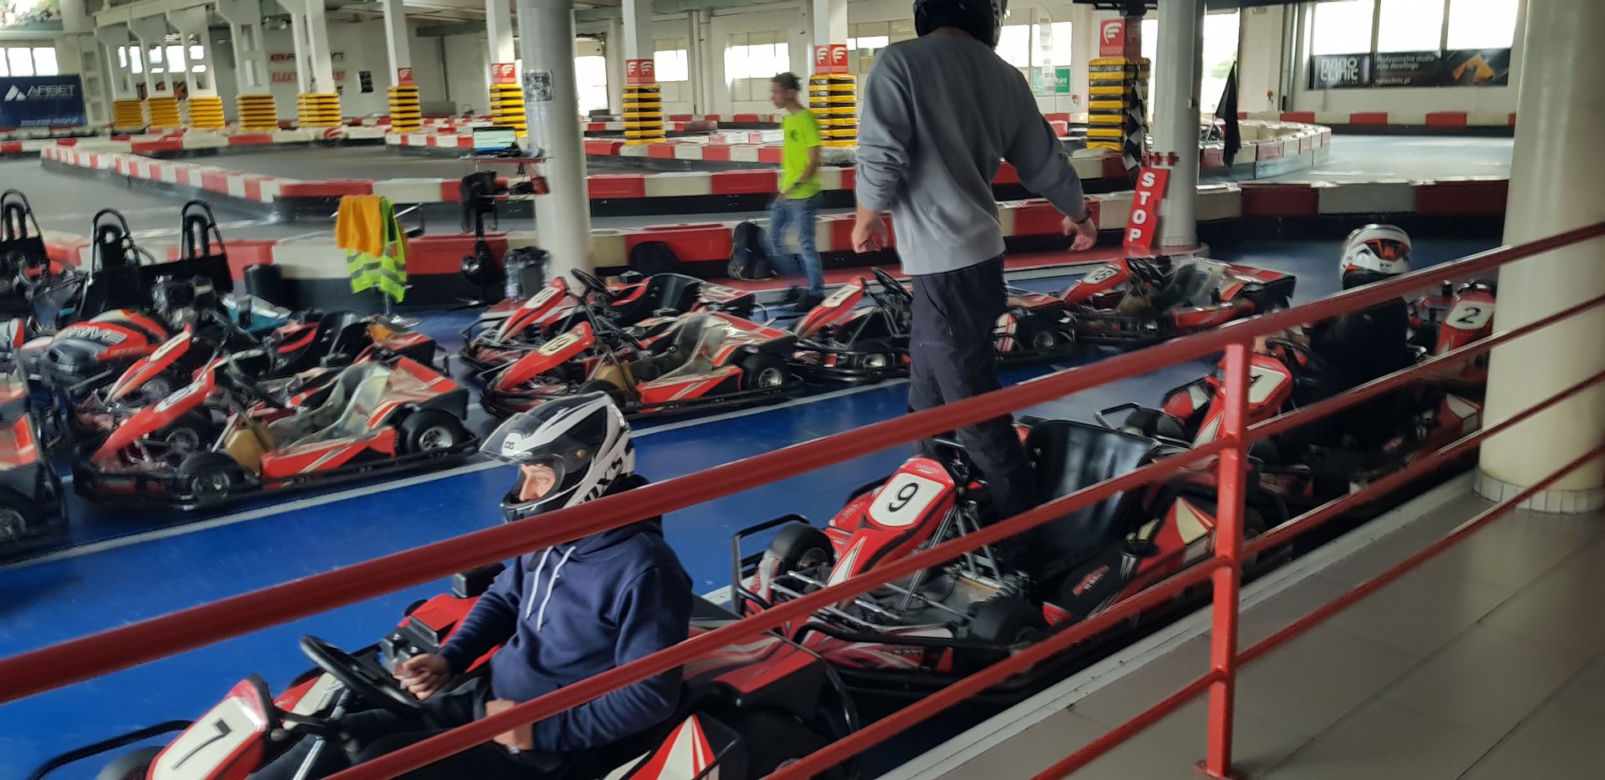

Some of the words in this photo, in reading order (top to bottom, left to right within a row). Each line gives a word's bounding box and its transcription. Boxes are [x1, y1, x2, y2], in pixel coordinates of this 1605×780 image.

[1128, 171, 1156, 242] STOP
[1456, 306, 1482, 324] 2
[888, 482, 919, 513] 9
[171, 718, 233, 769] 7
